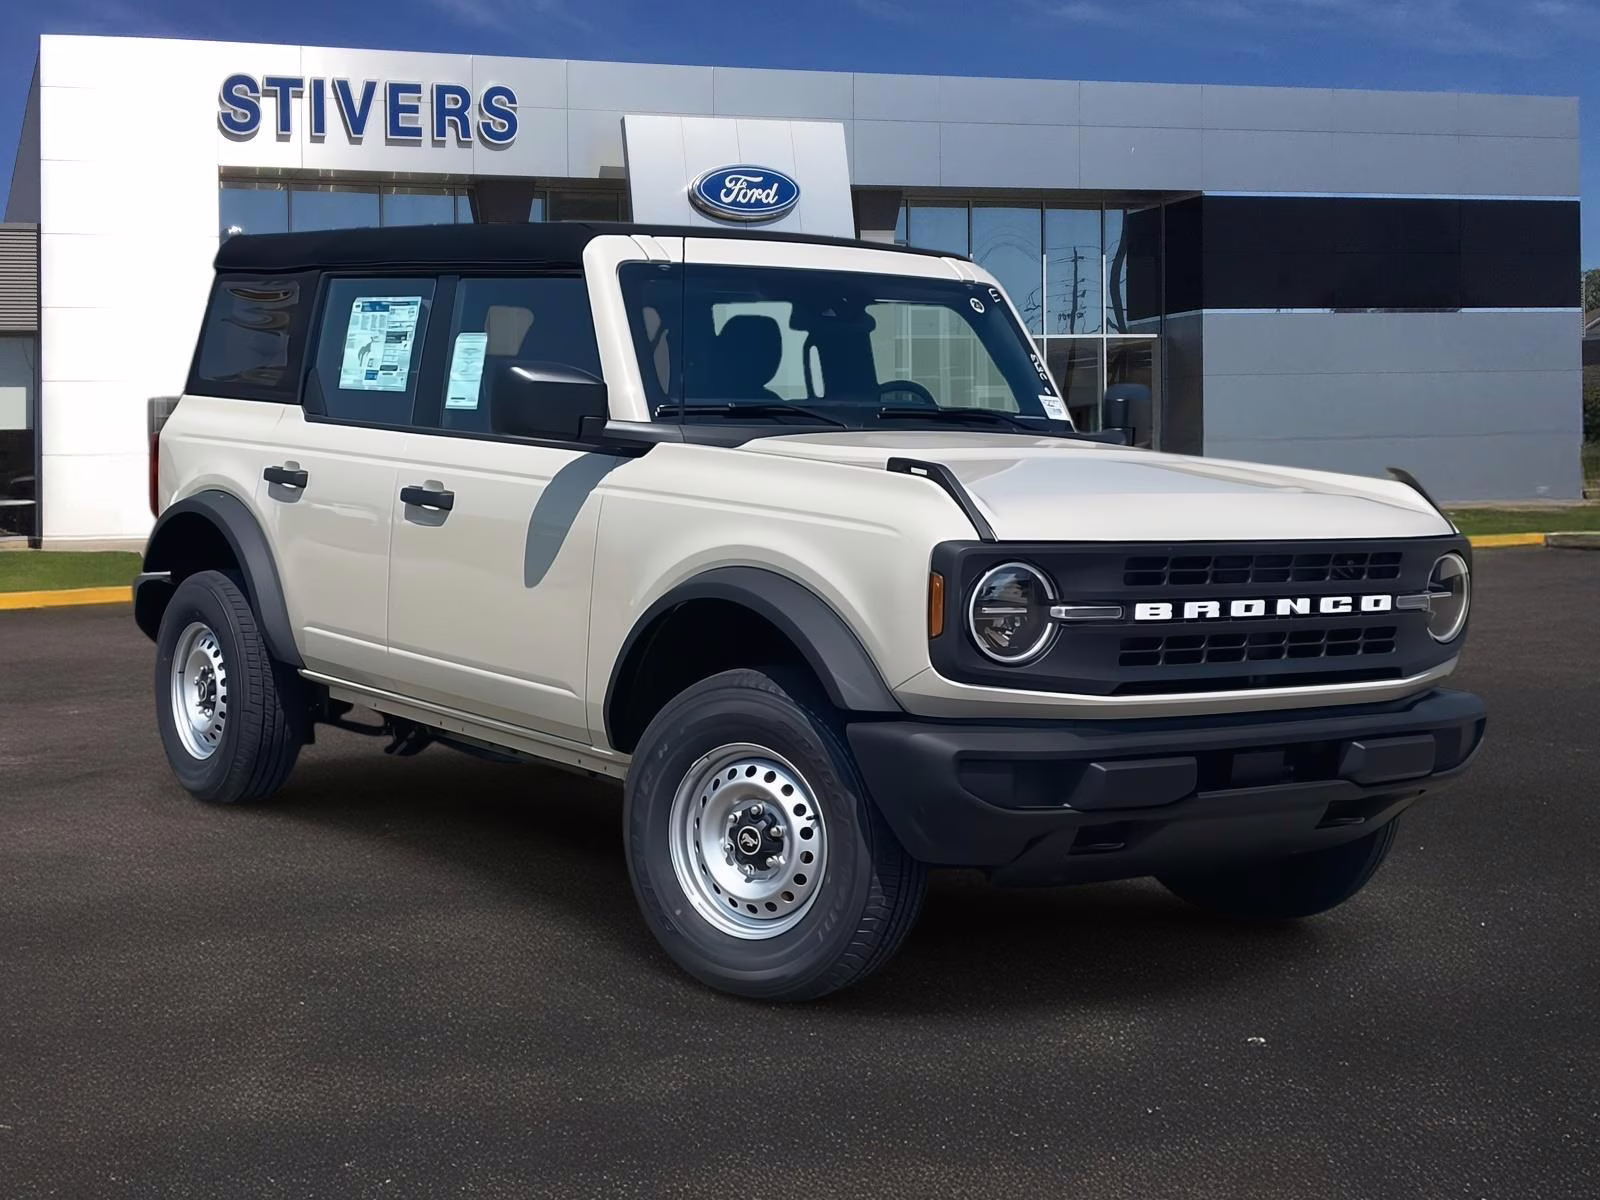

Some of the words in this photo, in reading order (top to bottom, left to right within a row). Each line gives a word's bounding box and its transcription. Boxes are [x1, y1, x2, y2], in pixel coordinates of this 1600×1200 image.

[219, 73, 519, 147] STIVERS
[720, 174, 779, 204] Ford
[1134, 595, 1393, 621] BRONCO
